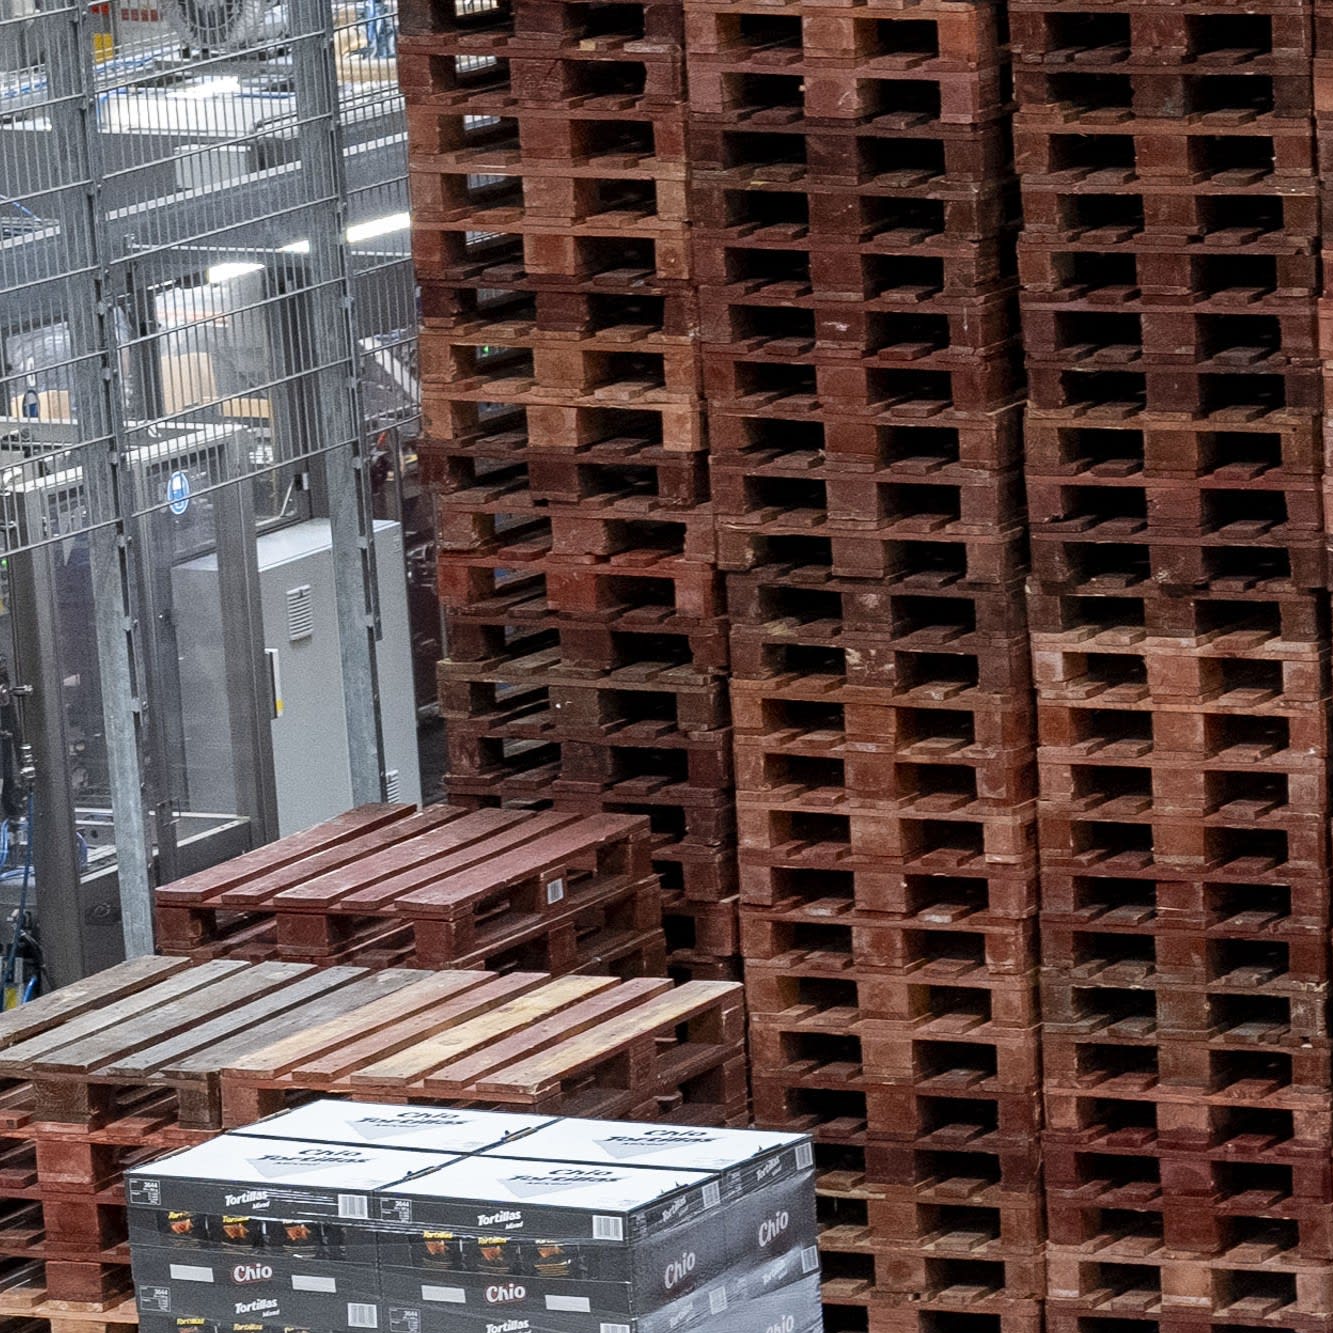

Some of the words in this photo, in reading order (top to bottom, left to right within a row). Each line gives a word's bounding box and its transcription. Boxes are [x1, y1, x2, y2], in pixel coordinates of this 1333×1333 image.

[396, 1111, 460, 1120] Chio
[357, 1118, 466, 1126] Tortillas
[643, 1128, 708, 1138] Chio
[604, 1136, 716, 1144] Tortillas
[298, 1148, 362, 1157] Chio
[258, 1155, 370, 1164] Tortillas
[548, 1168, 613, 1176] Chio
[510, 1174, 622, 1182] Tortillas
[225, 1190, 267, 1206] Tortillas
[477, 1210, 521, 1226] Tortillas
[758, 1212, 788, 1247] Chio
[234, 1264, 272, 1282] Chio
[665, 1252, 695, 1288] Chio
[486, 1284, 526, 1302] Chio
[235, 1298, 277, 1314] Tortillas
